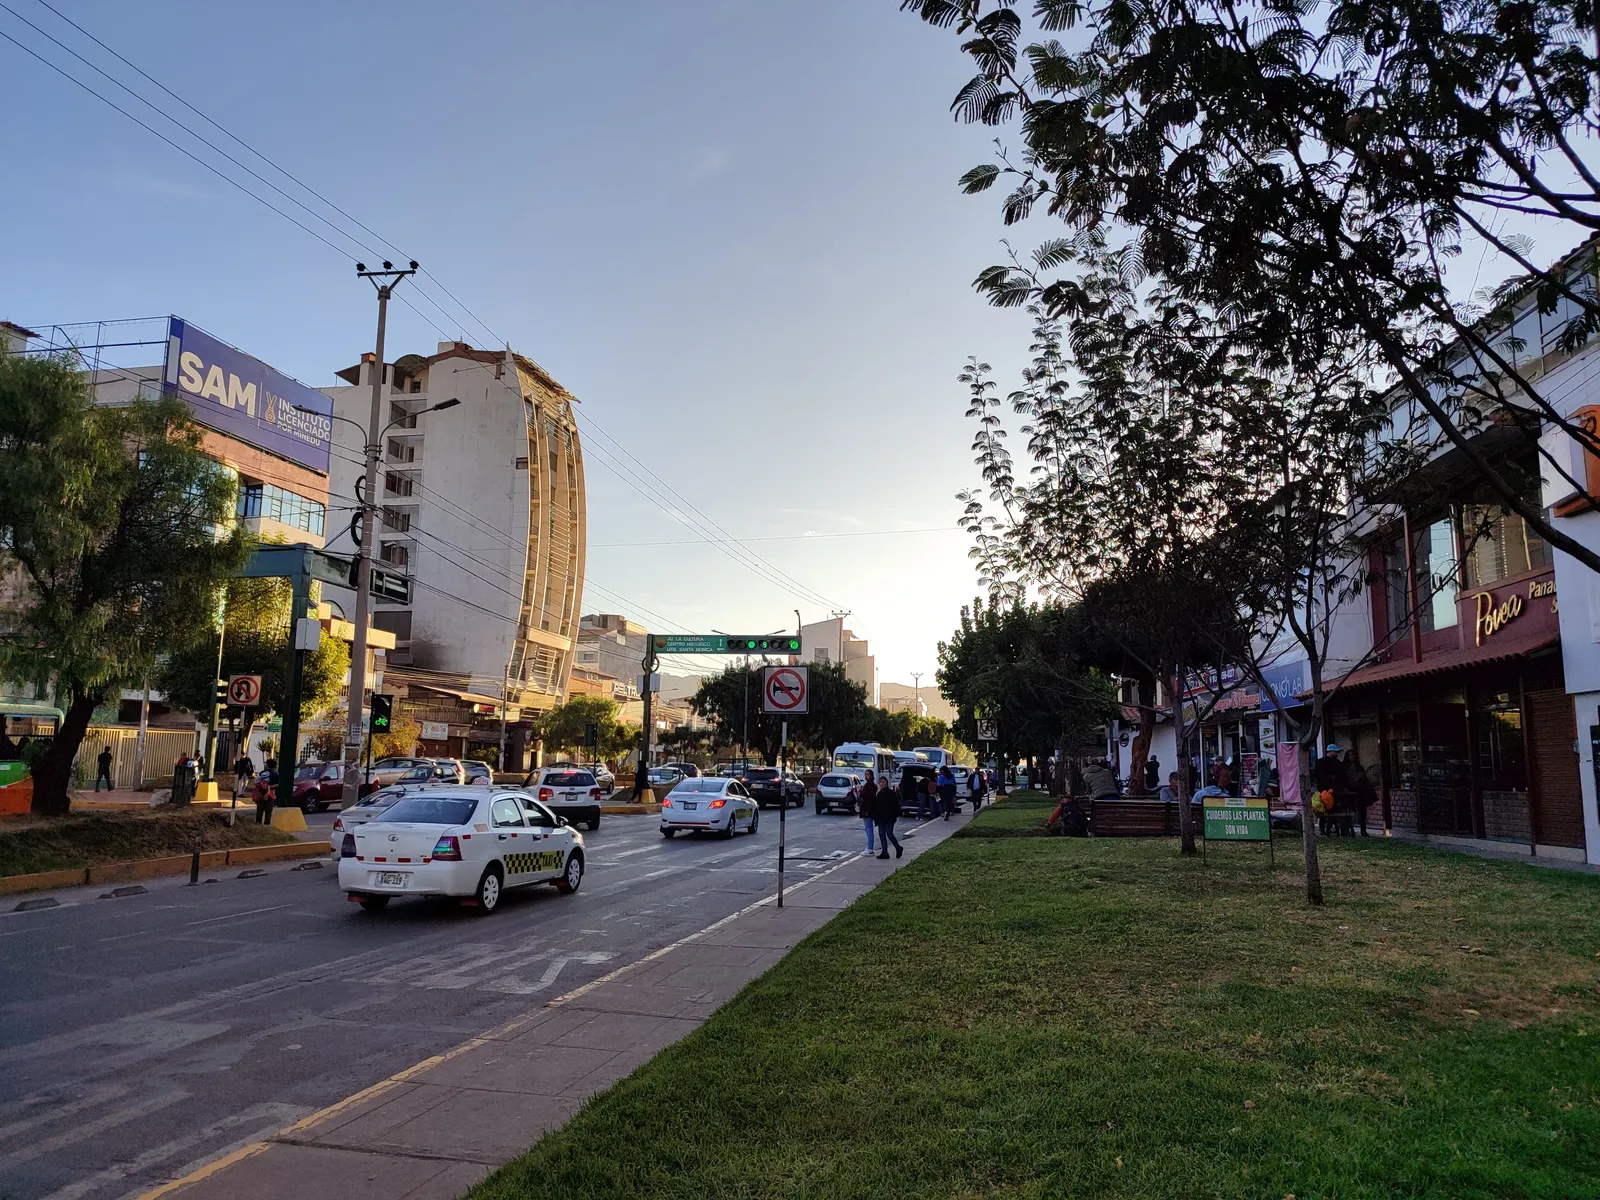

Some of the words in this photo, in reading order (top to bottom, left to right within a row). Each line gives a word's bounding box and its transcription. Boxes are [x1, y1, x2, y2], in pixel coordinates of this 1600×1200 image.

[279, 397, 331, 431] INSTITUTO
[277, 420, 292, 434] POR
[278, 409, 331, 441] LICENCIADO
[293, 428, 321, 446] MINEDU
[1471, 592, 1521, 647] Povea
[1206, 810, 1232, 820] CUIDEMOS
[1233, 811, 1243, 821] LAS
[1243, 811, 1267, 823] PLANTAS,
[1225, 825, 1236, 835] SON
[1236, 825, 1249, 835] VIDA
